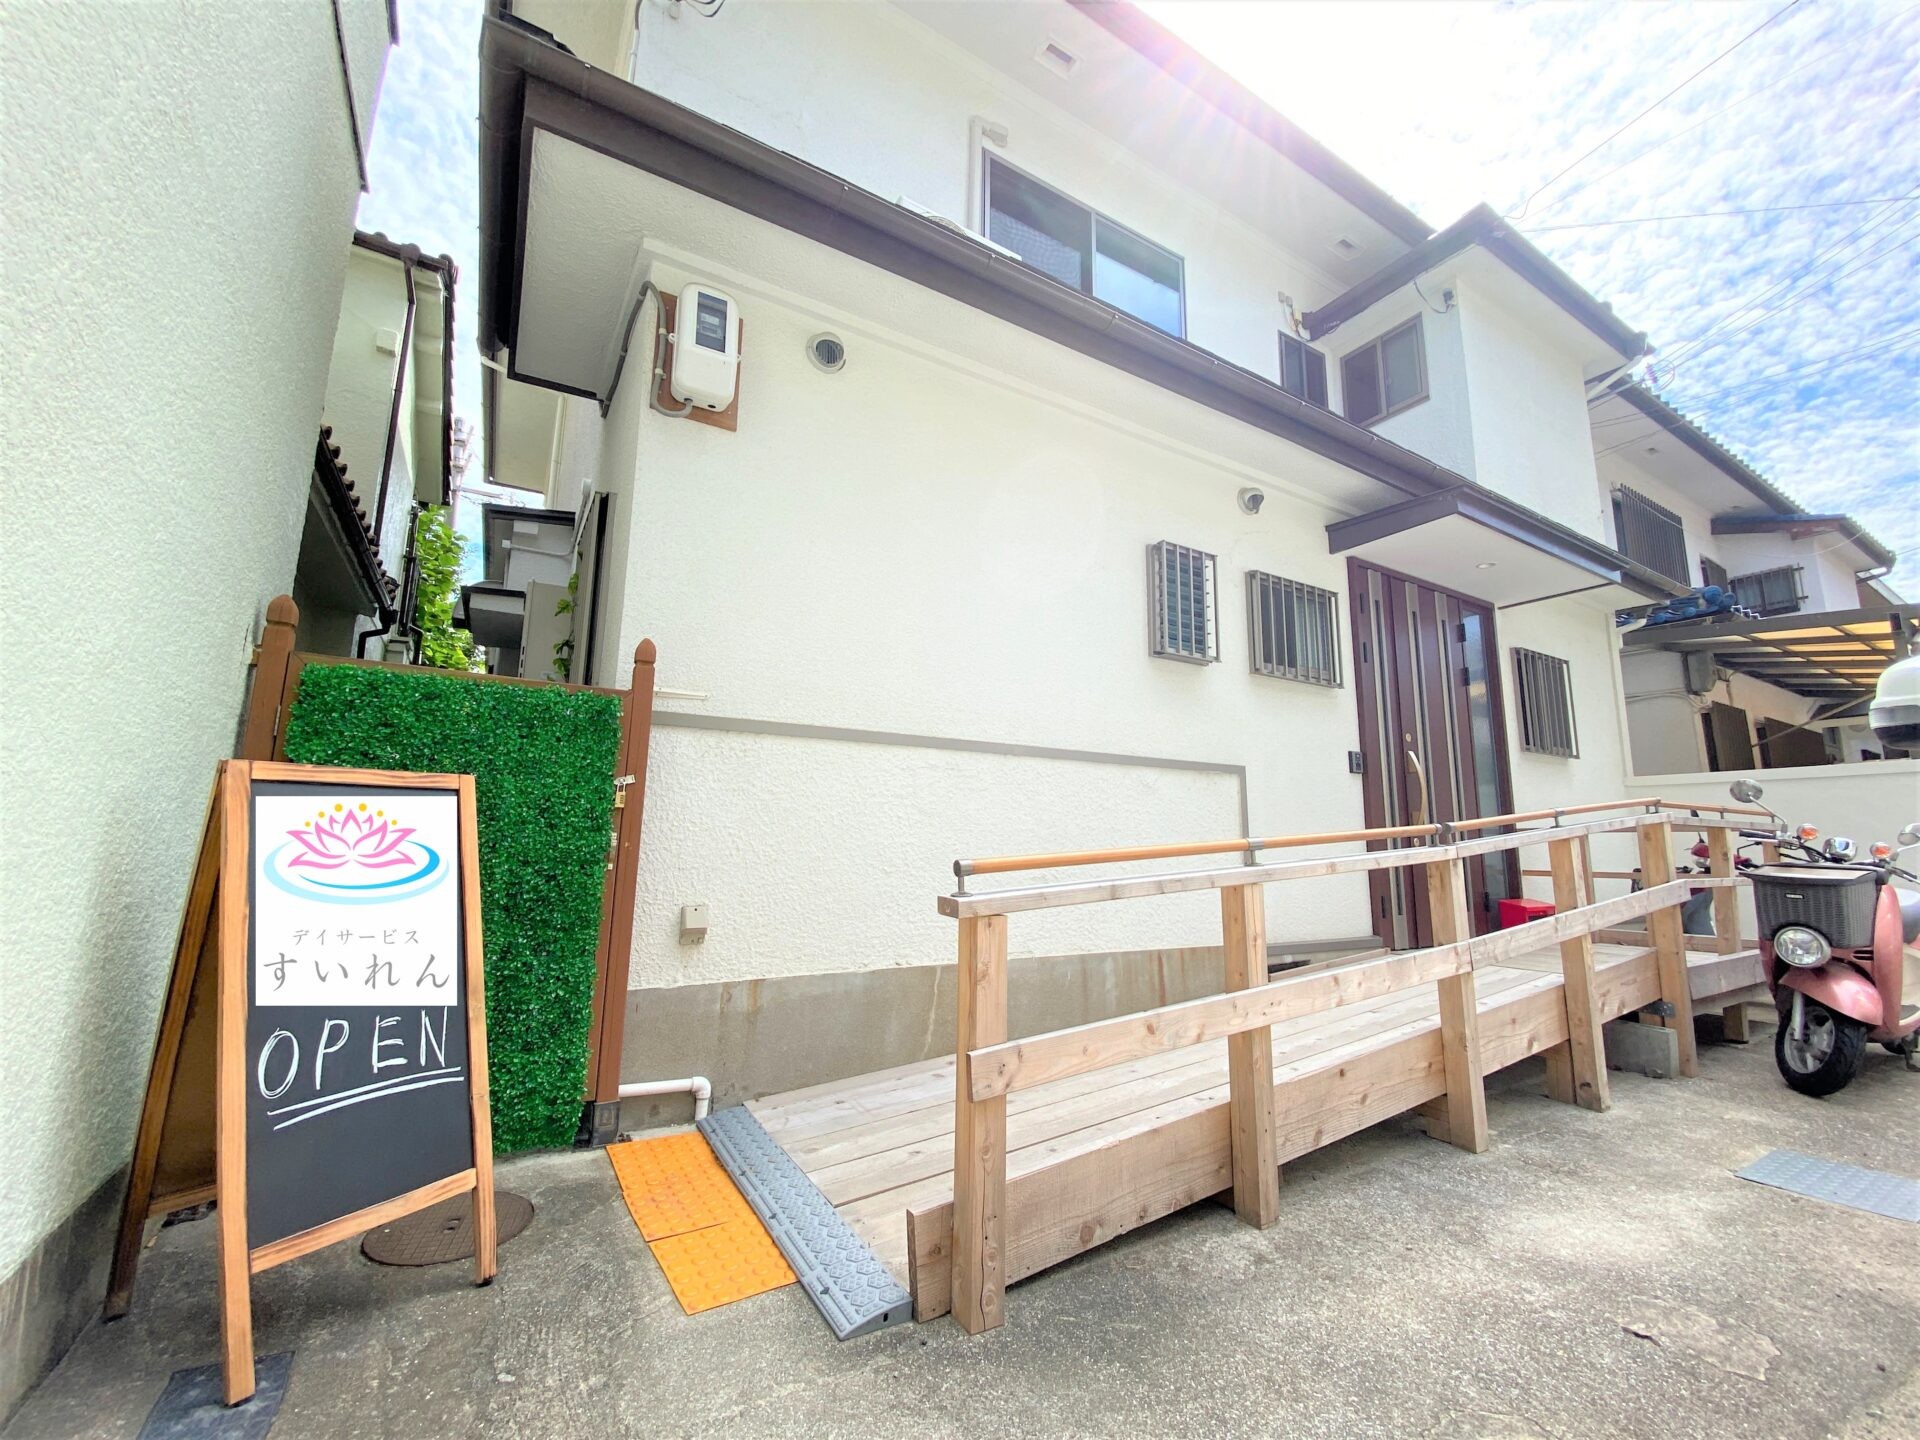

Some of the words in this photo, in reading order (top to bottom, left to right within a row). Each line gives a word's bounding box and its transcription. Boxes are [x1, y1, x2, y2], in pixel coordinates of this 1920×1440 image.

[292, 928, 420, 946] デイサービス
[263, 952, 450, 992] すいれん
[257, 1006, 448, 1099] OPEN
